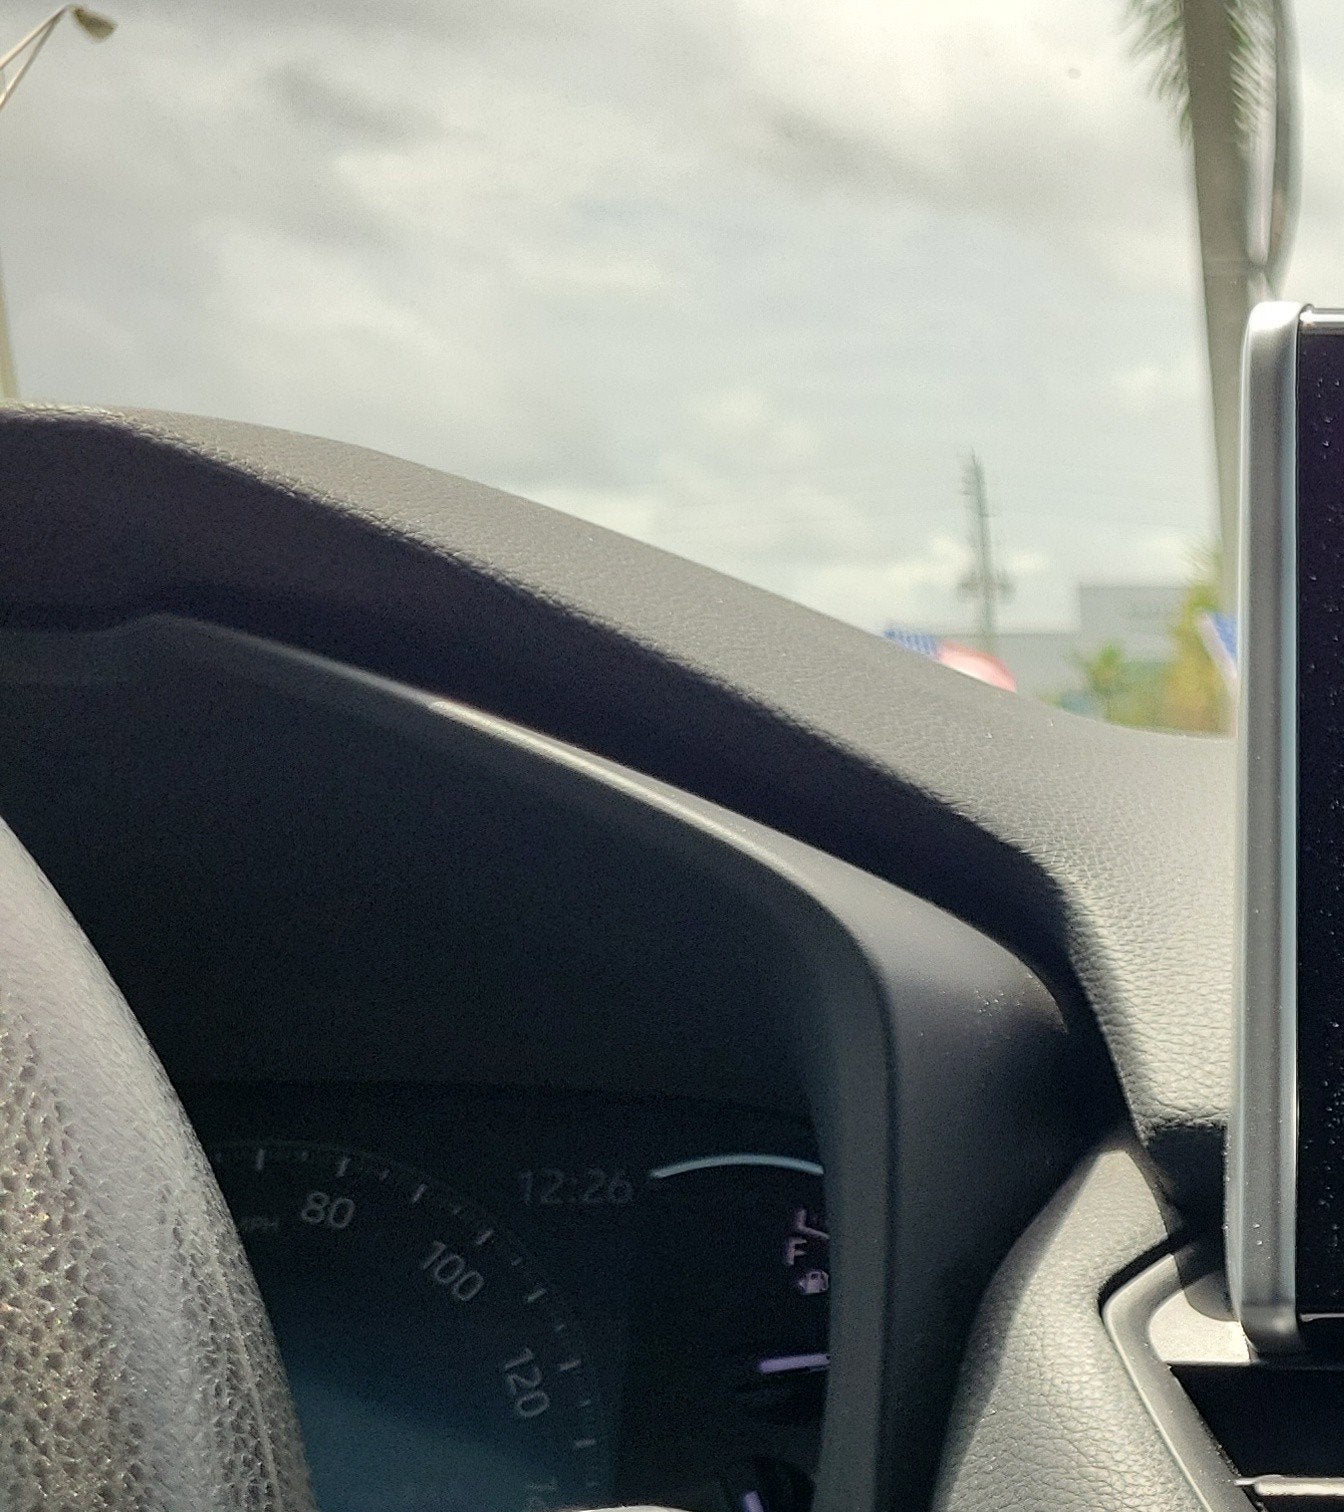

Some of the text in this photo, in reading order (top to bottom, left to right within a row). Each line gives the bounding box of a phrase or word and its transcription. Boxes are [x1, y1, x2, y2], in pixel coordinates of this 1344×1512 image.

[301, 1191, 355, 1230] 80
[519, 1168, 634, 1205] 12:26
[420, 1240, 486, 1302] 100
[504, 1347, 550, 1418] 120
